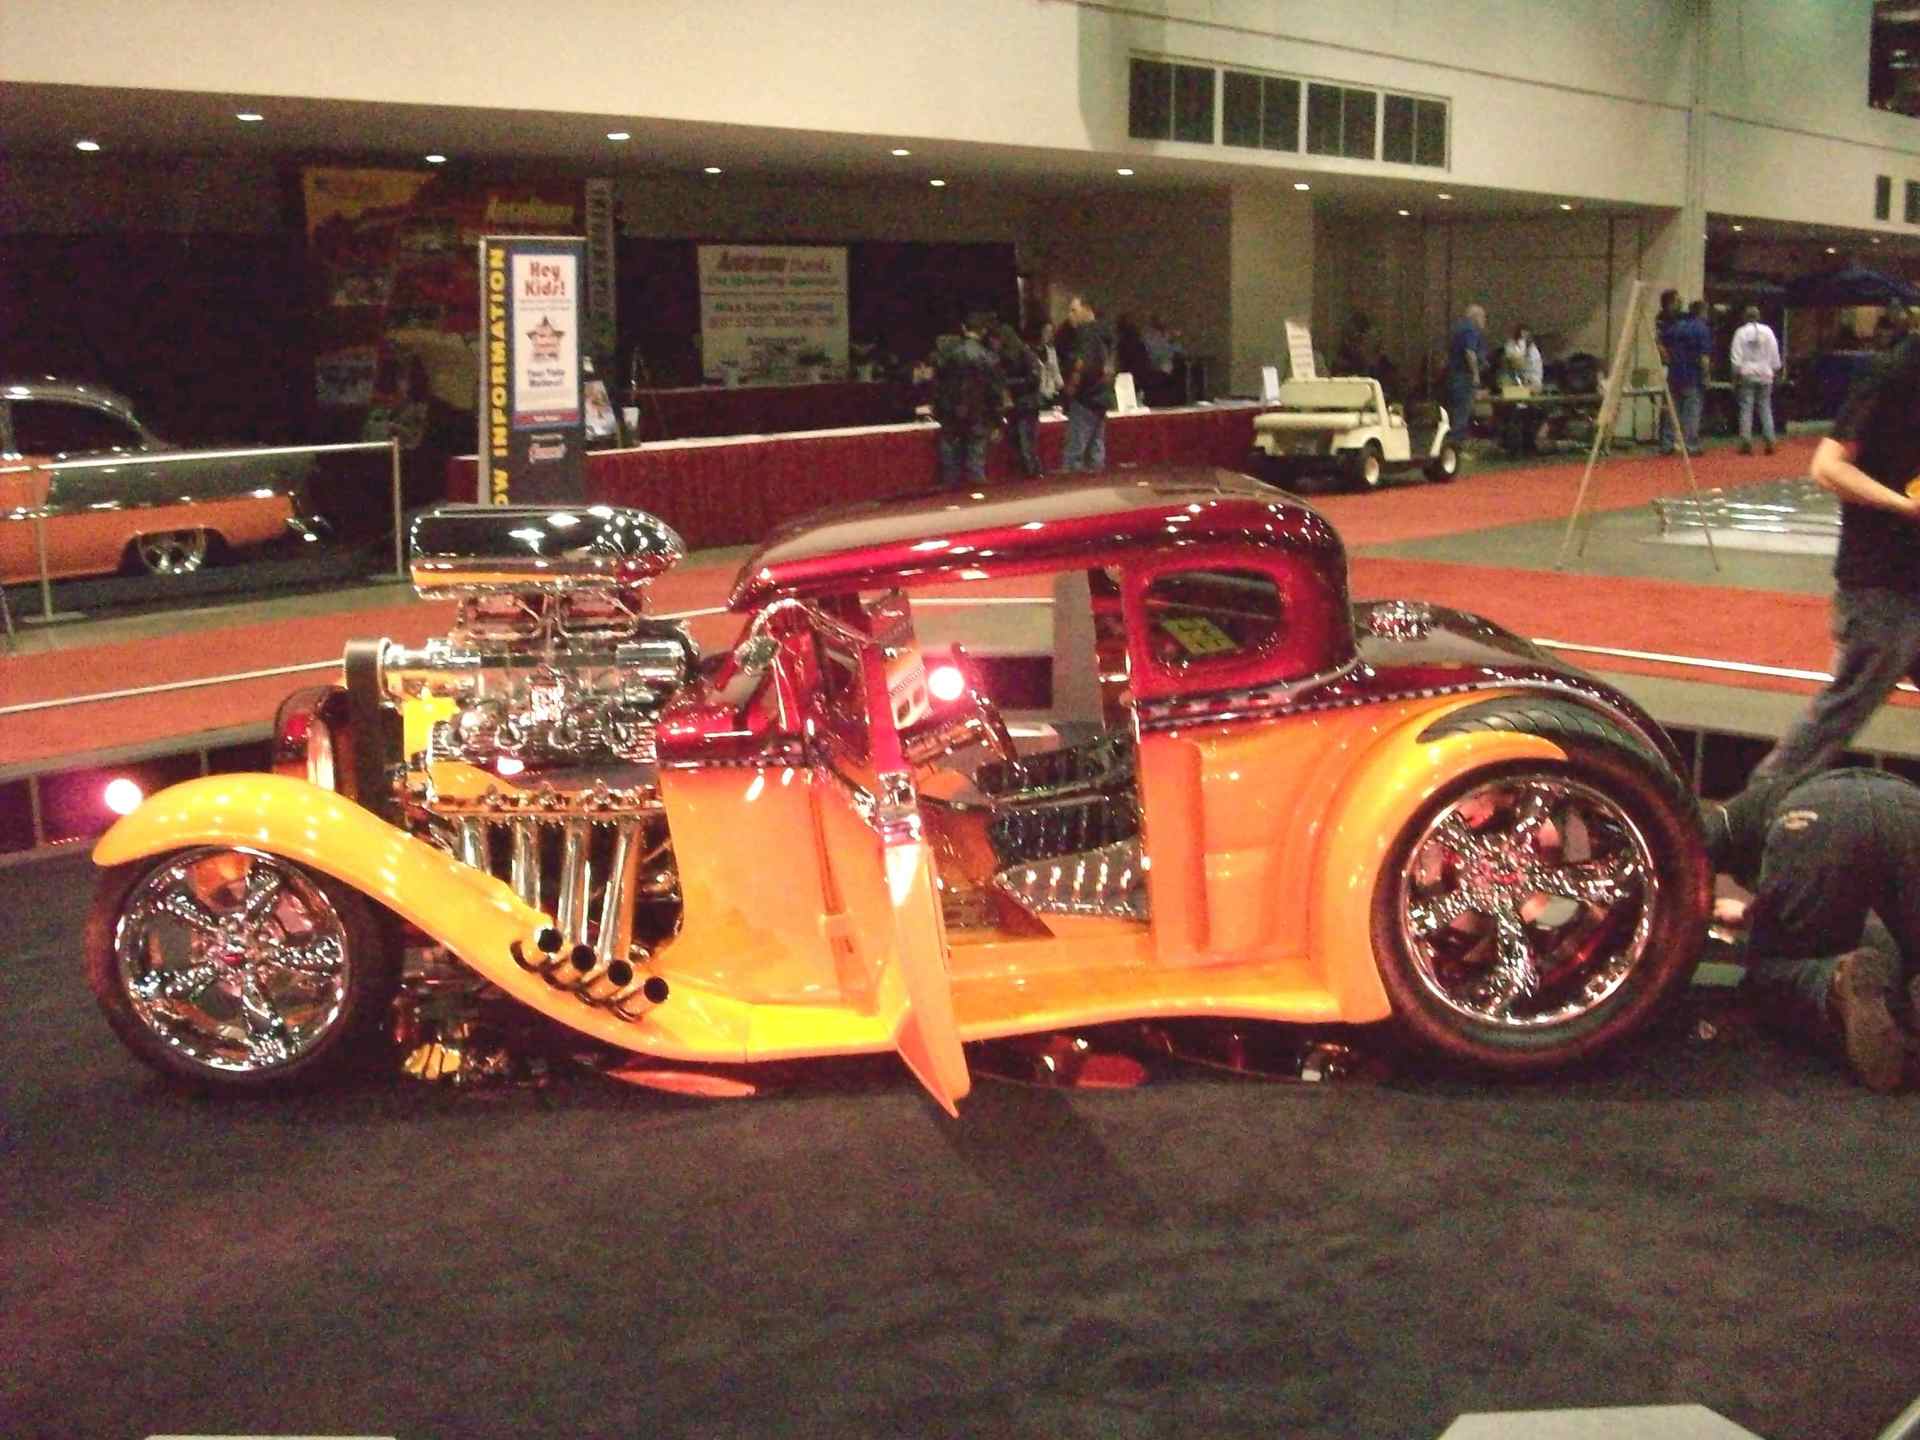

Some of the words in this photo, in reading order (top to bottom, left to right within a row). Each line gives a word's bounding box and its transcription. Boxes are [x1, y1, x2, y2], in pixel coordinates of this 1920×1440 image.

[529, 261, 560, 280] Hey
[525, 281, 565, 297] Kids!
[488, 249, 507, 457] INFORMATION
